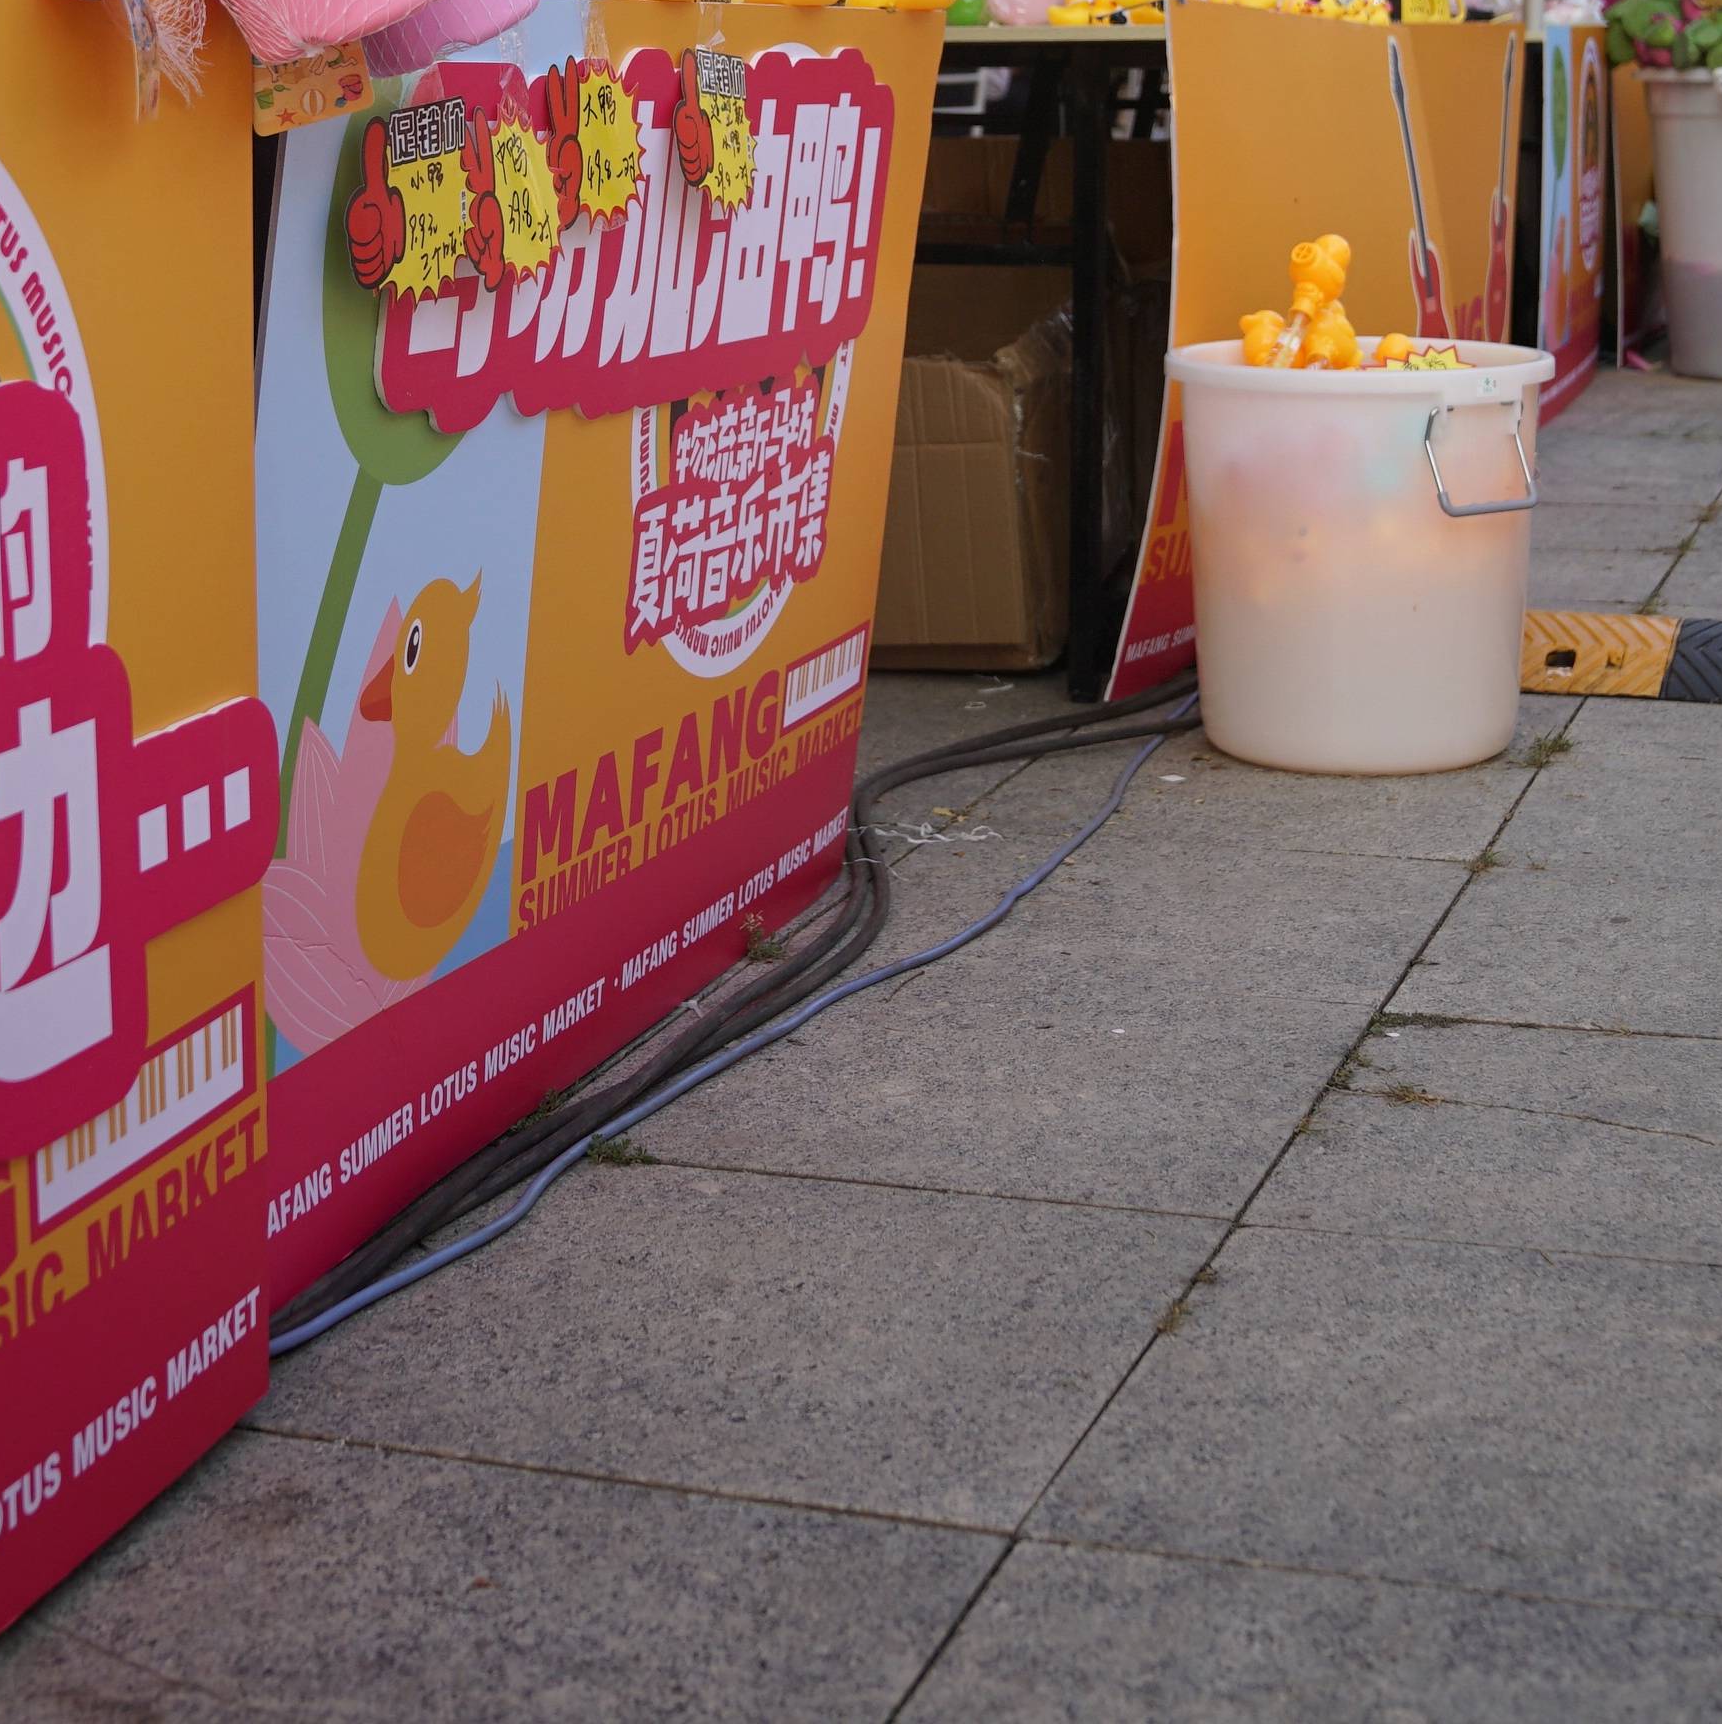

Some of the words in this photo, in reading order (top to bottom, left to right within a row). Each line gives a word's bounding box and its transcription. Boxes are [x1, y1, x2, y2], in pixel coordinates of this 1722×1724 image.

[390, 100, 465, 165] 促销价
[696, 50, 747, 98] 促销价
[630, 451, 831, 638] 夏荷音乐市集
[517, 832, 632, 933] SUMMER
[643, 786, 717, 864] LOTUS
[726, 745, 789, 814] MUSIC
[795, 697, 863, 775] MARKET
[520, 669, 781, 887] MAFANG
[266, 1161, 332, 1241] AFANG
[339, 1102, 414, 1184] SUMMER
[420, 1059, 478, 1126] LOTUS
[484, 1023, 537, 1083] MUSIC
[542, 977, 606, 1044] MARKET
[621, 930, 677, 991] MAFANG
[682, 891, 734, 949] SUMMER
[737, 863, 775, 911] LOTUS
[777, 838, 811, 882] MUSIC
[812, 805, 849, 857] MARKET
[87, 1108, 262, 1278] MARKET
[72, 1374, 160, 1477] MUSIC
[166, 1285, 262, 1400] MARKET
